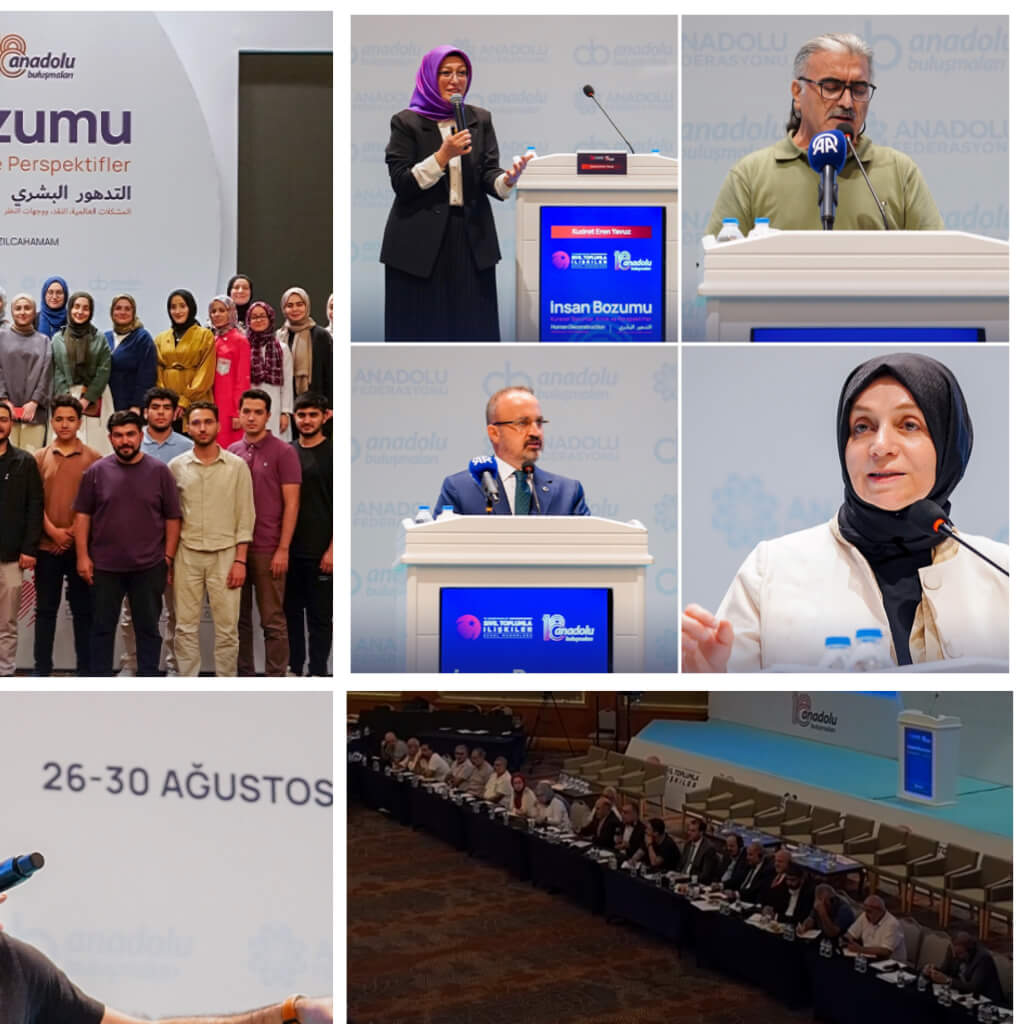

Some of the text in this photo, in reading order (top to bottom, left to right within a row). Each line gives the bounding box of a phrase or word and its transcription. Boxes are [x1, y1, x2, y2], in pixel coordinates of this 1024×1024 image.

[9, 52, 75, 69] anadolu
[7, 156, 131, 176] Perspektifler
[11, 184, 131, 206] التدهور البشري
[593, 300, 652, 314] Bozumu
[537, 367, 618, 386] anadolu
[366, 432, 448, 450] anadolu
[544, 436, 619, 450] NADOLU
[555, 625, 595, 636] anadolu
[800, 707, 838, 727] anadolu
[42, 762, 334, 807] 26-30 AĞUSTOS
